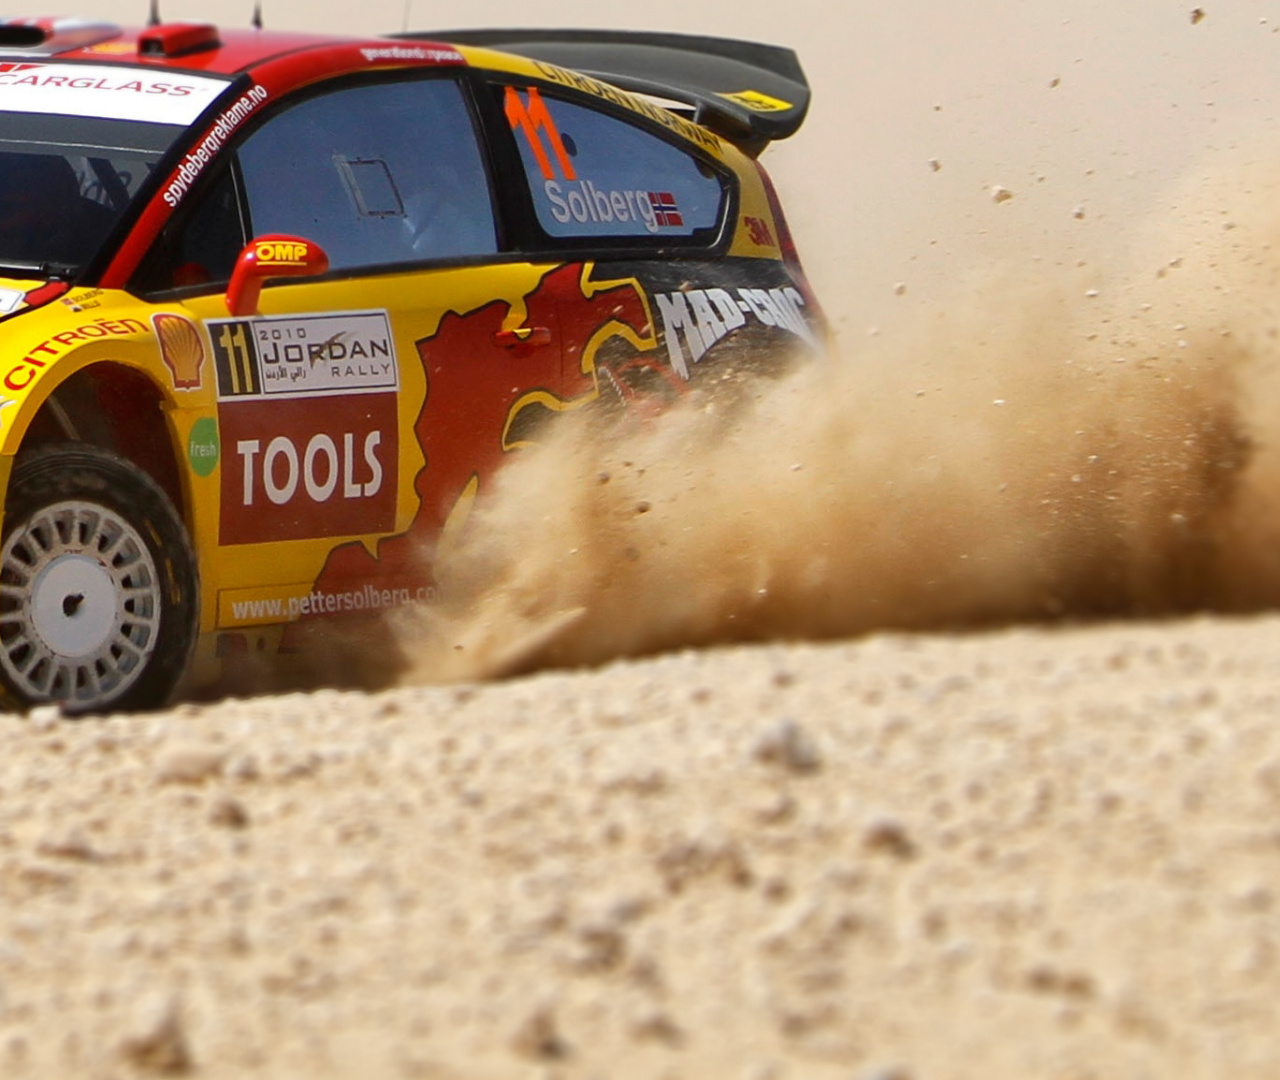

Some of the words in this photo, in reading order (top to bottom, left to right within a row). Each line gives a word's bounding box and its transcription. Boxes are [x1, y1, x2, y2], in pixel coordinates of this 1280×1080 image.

[163, 84, 268, 208] spydebergreklame.no
[504, 86, 577, 181] 11
[544, 179, 658, 232] Solberg
[255, 244, 308, 262] OMP
[219, 324, 254, 394] 11
[260, 328, 306, 341] 2010
[263, 339, 390, 365] JORDAN
[654, 287, 815, 380] MAD-CROC
[331, 363, 390, 377] RALLY
[190, 440, 217, 458] fresh
[237, 430, 383, 506] TOOLS
